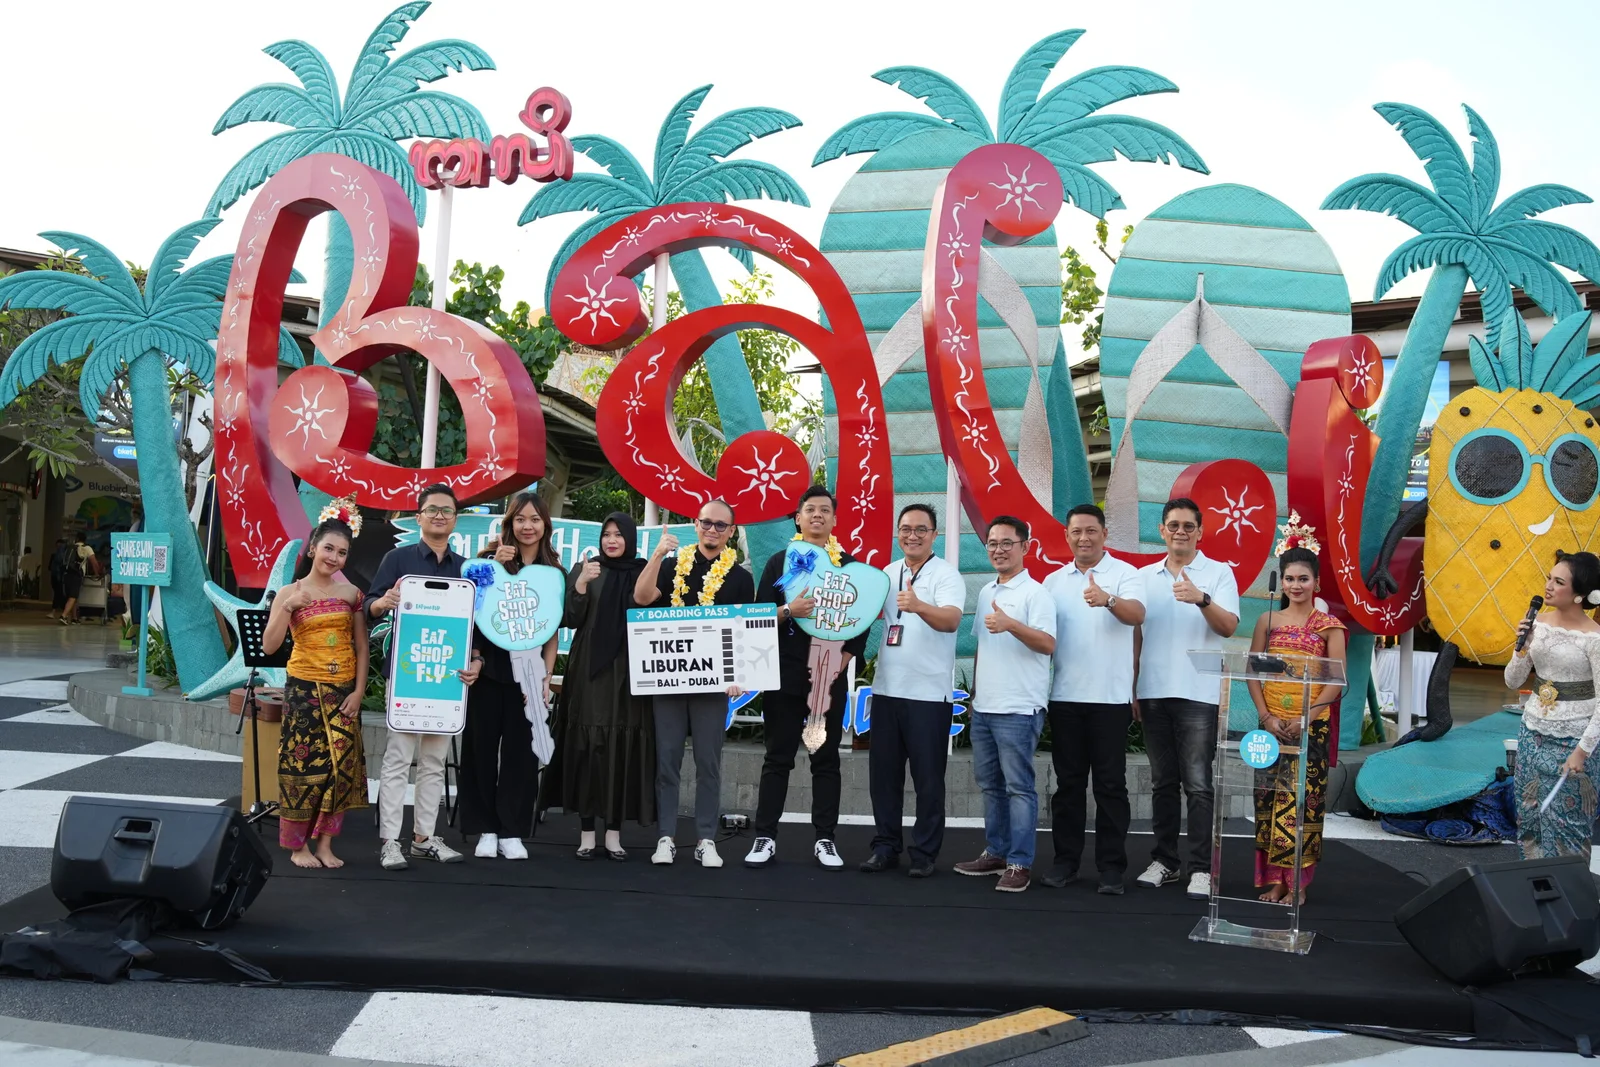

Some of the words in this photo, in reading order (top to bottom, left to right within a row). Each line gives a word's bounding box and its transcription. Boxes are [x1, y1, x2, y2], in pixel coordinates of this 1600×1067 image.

[88, 482, 128, 493] Bluebird
[504, 580, 528, 600] EAT
[823, 571, 850, 591] EAT
[813, 586, 854, 611] SHOP
[498, 596, 538, 621] SHOP
[648, 608, 701, 619] BOARDING
[705, 607, 729, 616] PASS
[816, 609, 846, 632] FLY
[420, 627, 447, 645] EAT
[507, 618, 536, 642] FLY
[410, 643, 454, 664] SHOP
[649, 639, 694, 654] TIKET
[416, 663, 447, 684] FLY
[642, 658, 713, 673] LIBURAN
[657, 678, 679, 687] BALI
[688, 676, 719, 687] DUBAI
[1247, 742, 1271, 753] SHOP
[1253, 734, 1267, 743] EAT
[1251, 752, 1268, 764] FLY
